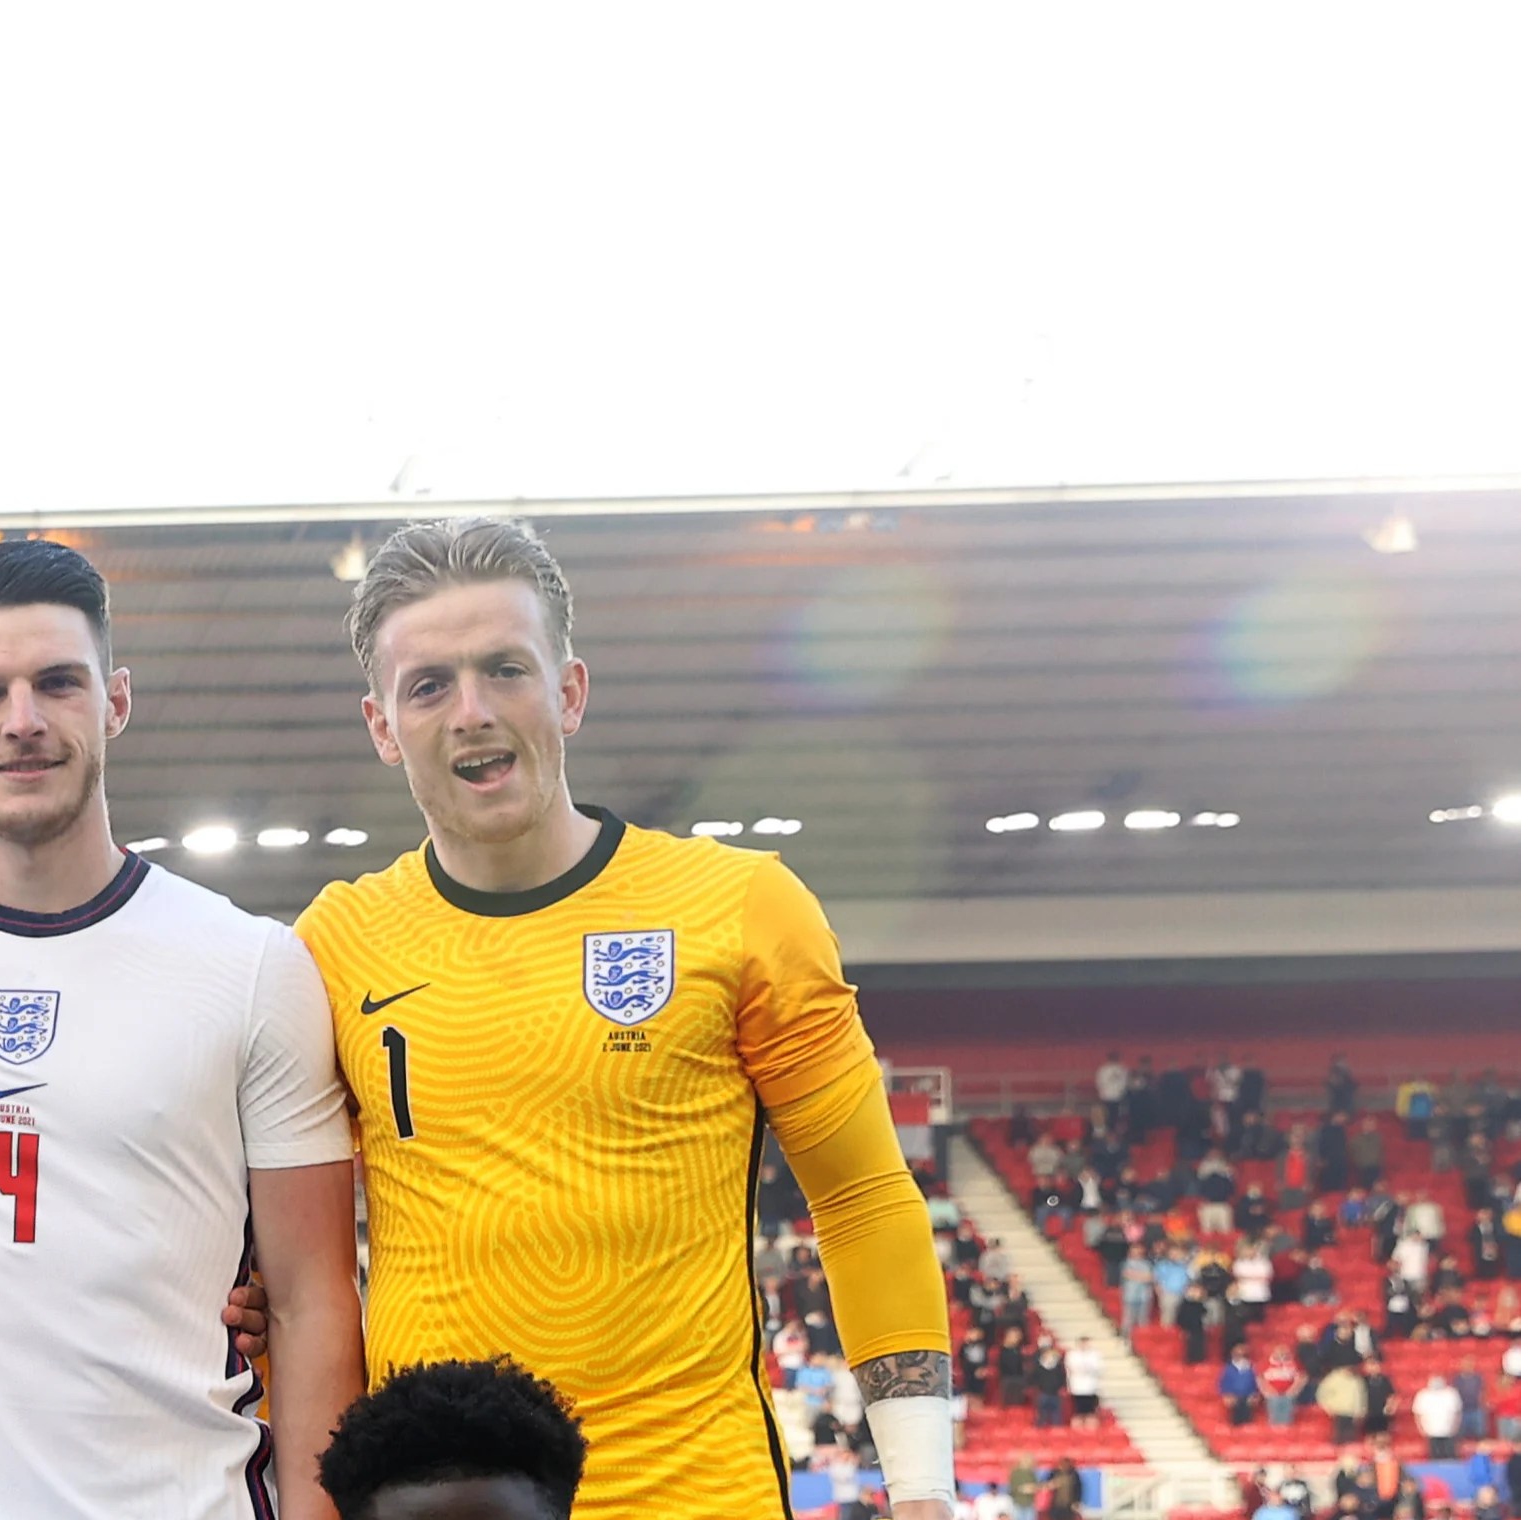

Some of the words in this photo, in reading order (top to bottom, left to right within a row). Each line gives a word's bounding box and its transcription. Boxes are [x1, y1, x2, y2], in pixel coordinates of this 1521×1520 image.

[607, 1030, 646, 1041] AUSTRIA
[382, 1024, 415, 1140] 1
[18, 1116, 35, 1127] 2021
